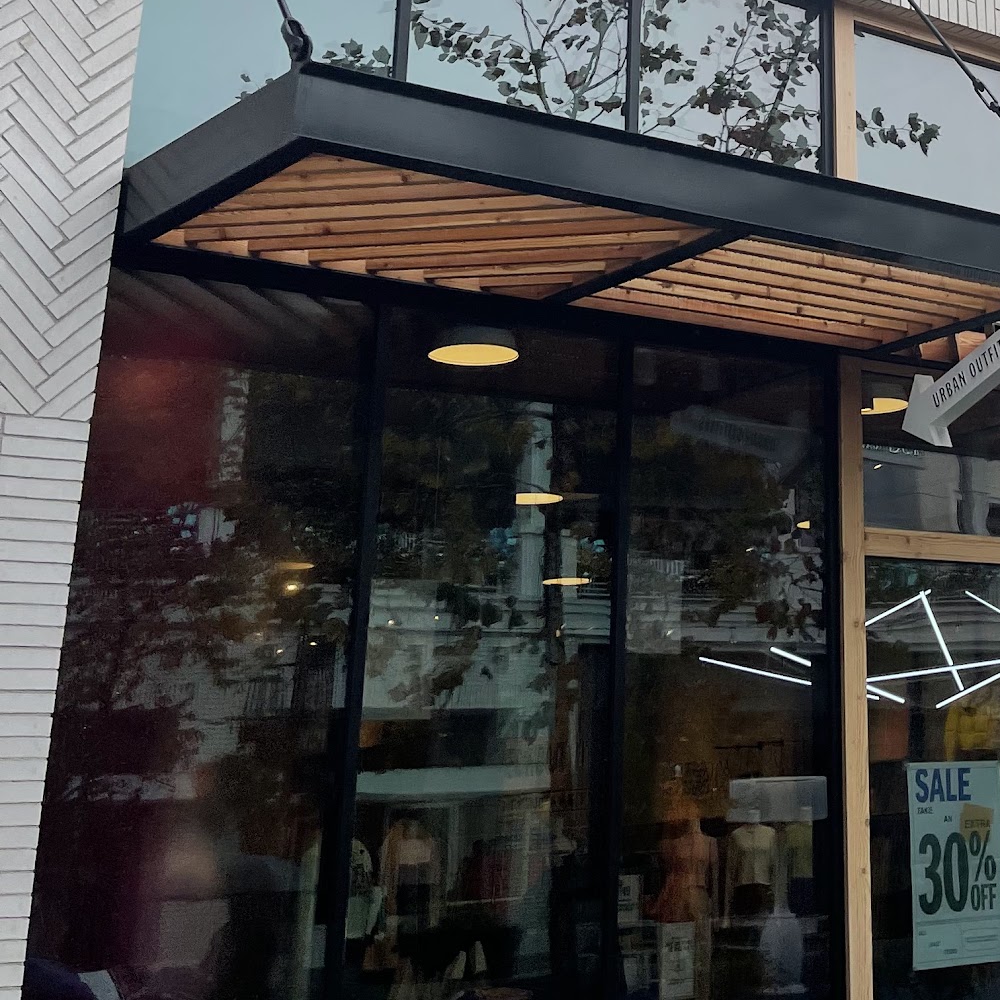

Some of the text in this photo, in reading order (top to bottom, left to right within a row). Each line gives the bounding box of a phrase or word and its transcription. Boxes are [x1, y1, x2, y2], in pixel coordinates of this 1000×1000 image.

[932, 371, 967, 408] URBAN
[915, 767, 972, 804] SALE
[964, 818, 991, 829] EXTRA
[918, 829, 997, 915] 30%
[970, 883, 997, 912] OFF
